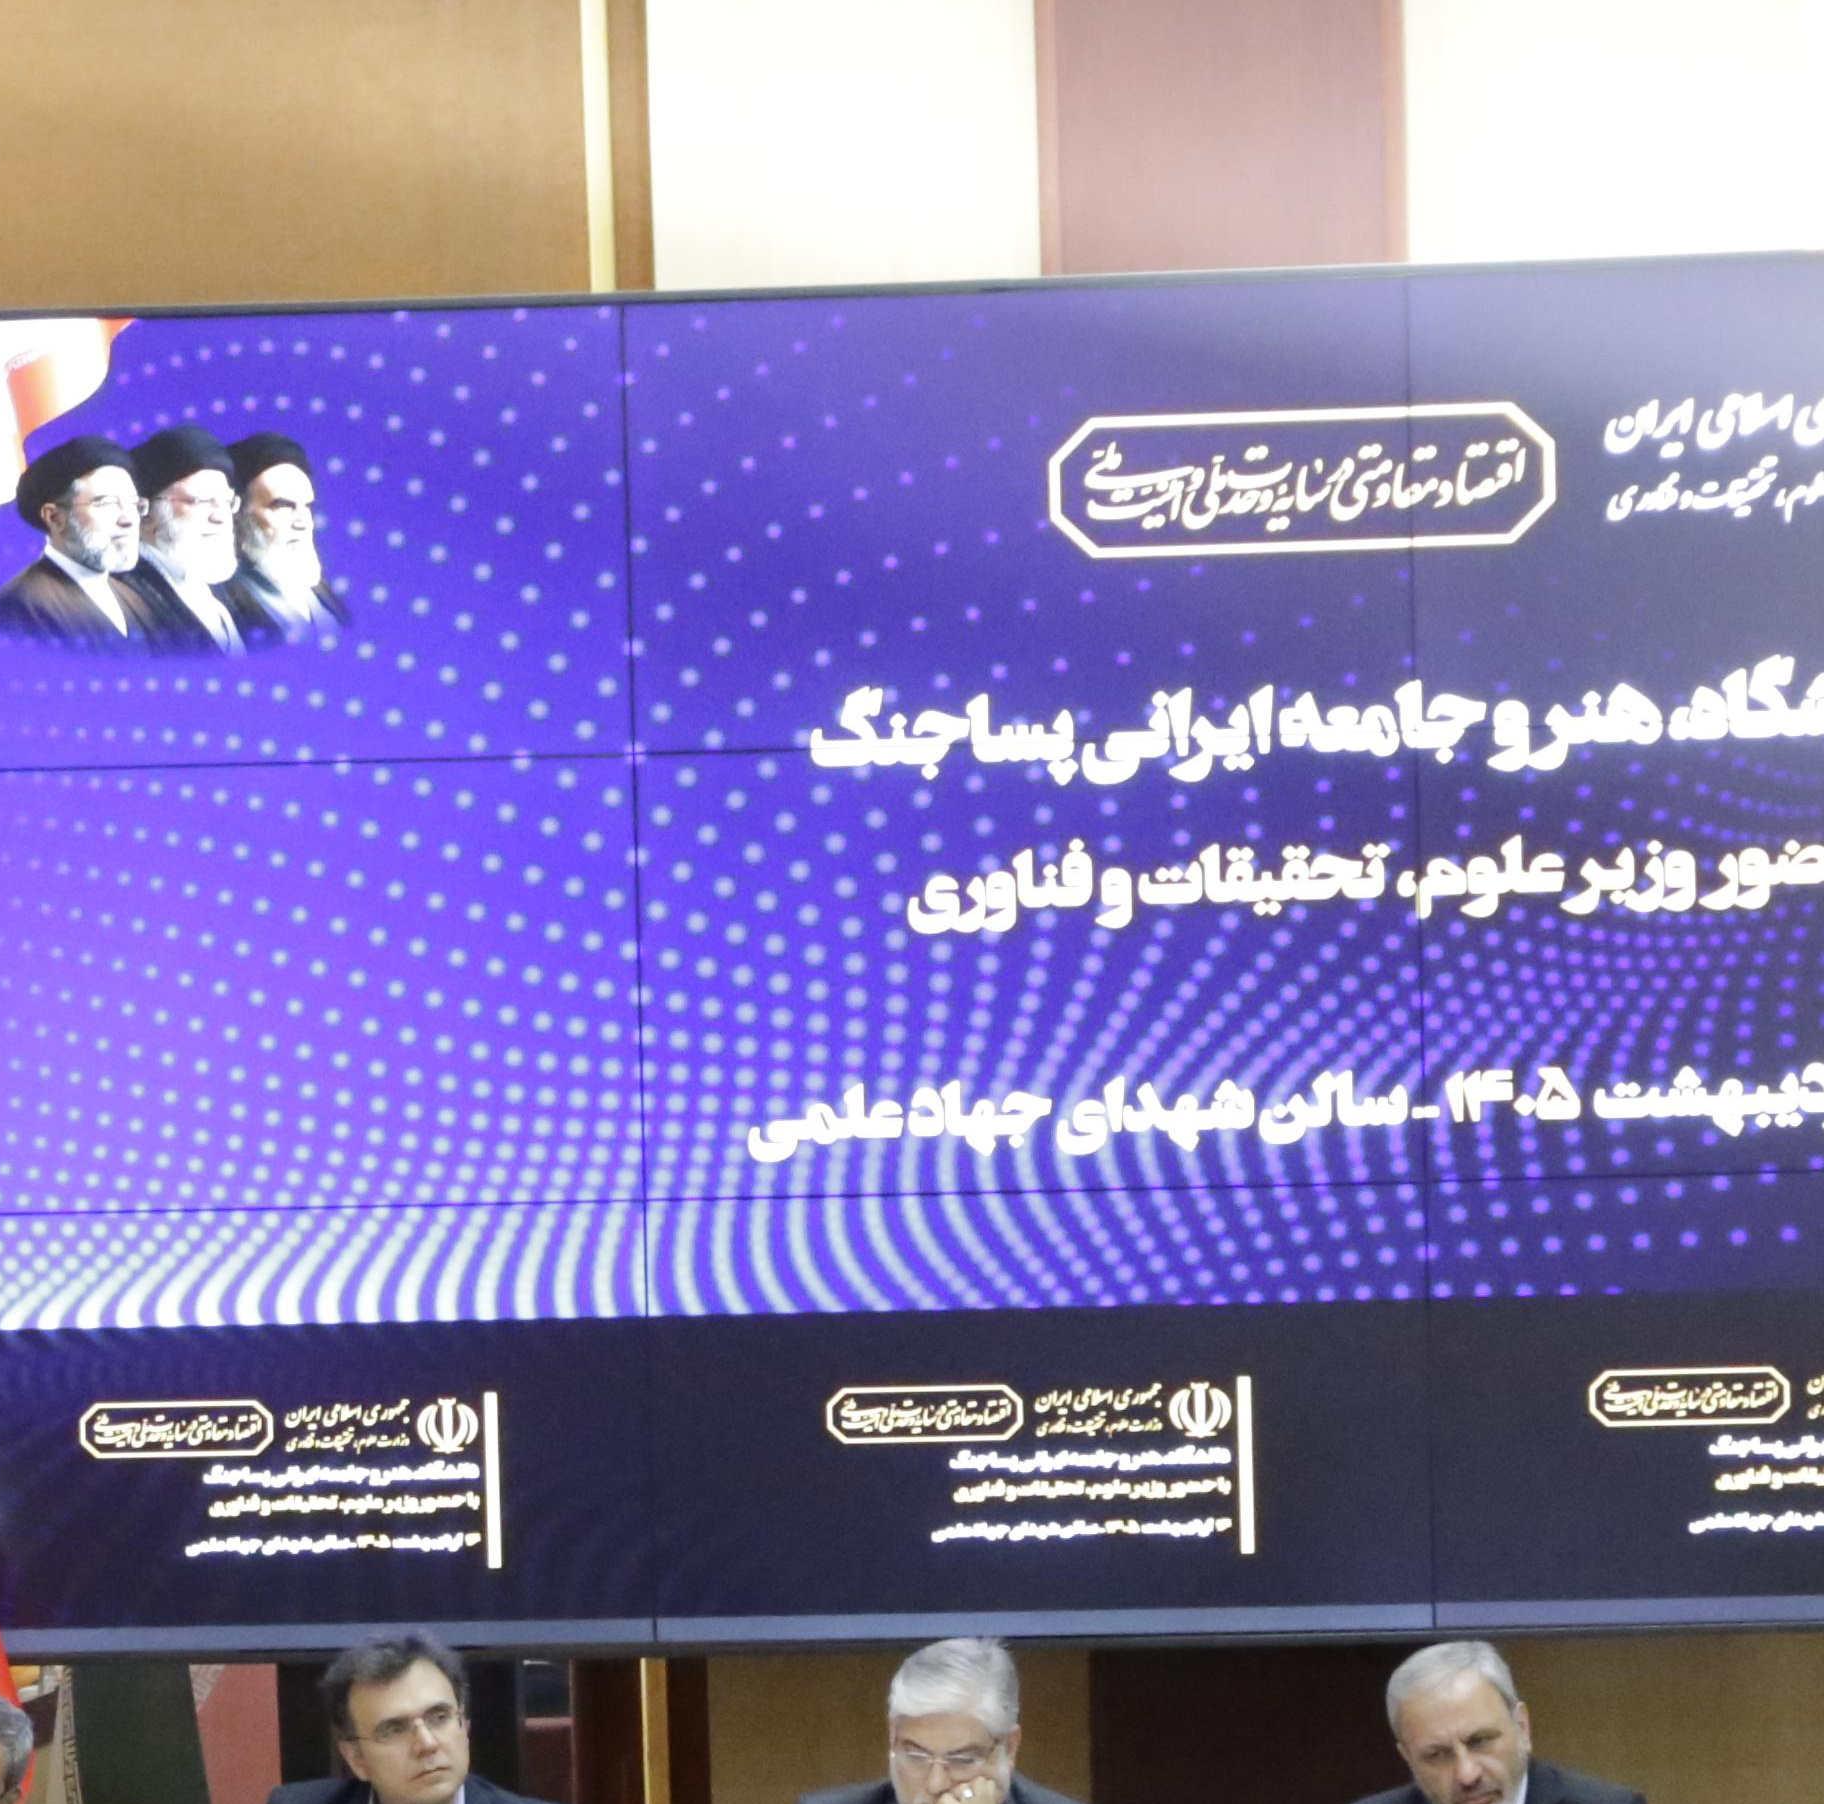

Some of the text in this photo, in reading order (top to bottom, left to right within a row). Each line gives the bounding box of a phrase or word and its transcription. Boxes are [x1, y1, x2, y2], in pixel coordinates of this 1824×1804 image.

[1604, 398, 1695, 458] ایران
[1696, 392, 1794, 450] اسلامی
[1082, 686, 1273, 784] ایرانی
[1280, 681, 1487, 763] جامعه
[1488, 700, 1530, 771] و
[1528, 684, 1663, 771] هنر
[909, 840, 1093, 934] فناوری
[1096, 869, 1132, 929] و
[1139, 844, 1390, 915] تحقیقات
[1398, 836, 1564, 919] علوم،
[1562, 841, 1696, 914] وزیر
[749, 1084, 904, 1163] علمی
[909, 1081, 1052, 1157] جهاد
[1057, 1077, 1255, 1155] شهدای
[1260, 1071, 1408, 1145] سالن
